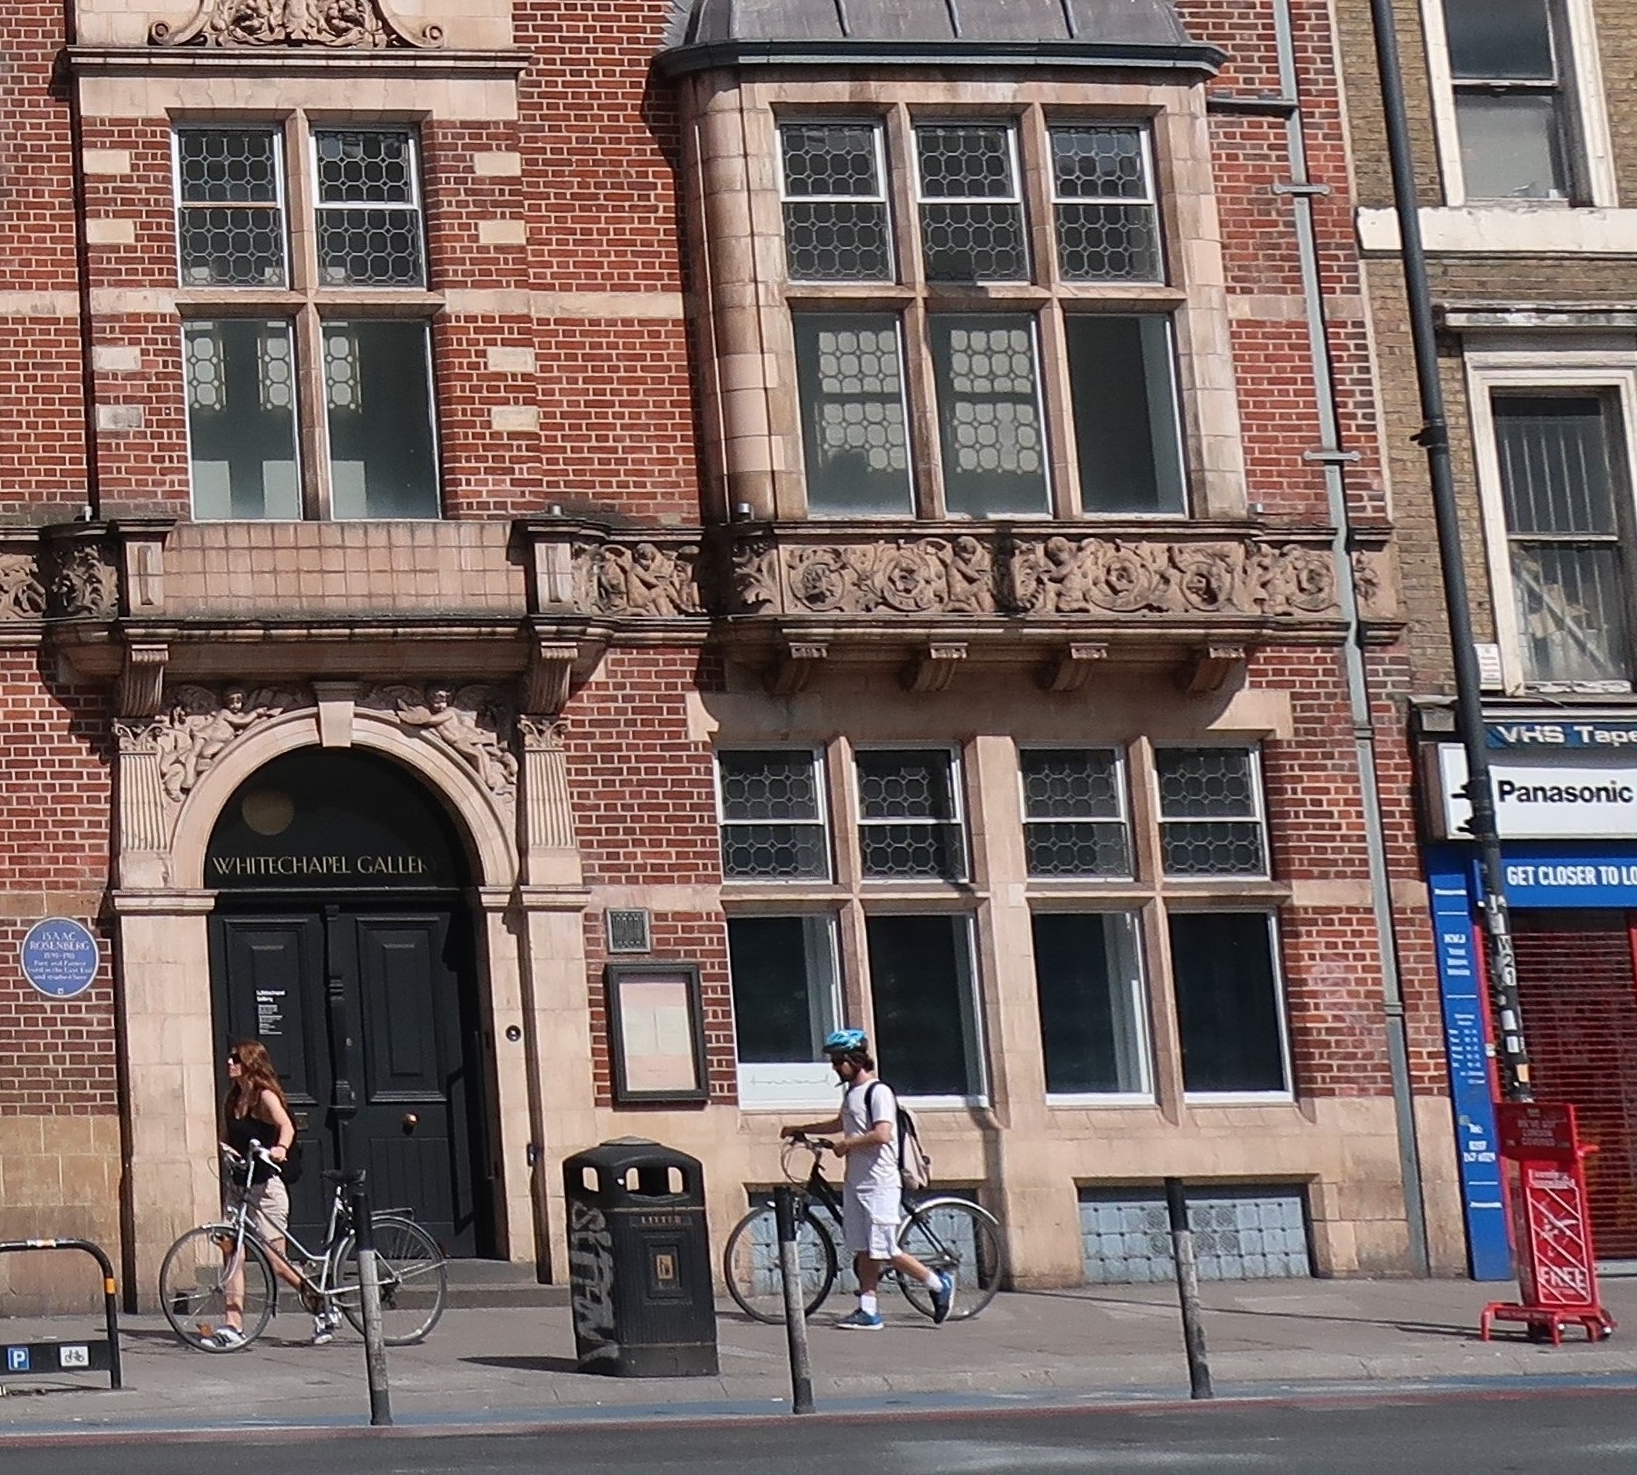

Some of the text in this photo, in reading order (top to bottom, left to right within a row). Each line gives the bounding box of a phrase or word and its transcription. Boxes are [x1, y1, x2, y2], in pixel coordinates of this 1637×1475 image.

[1496, 725, 1565, 743] VHS
[1497, 780, 1634, 803] Panasonic
[212, 856, 352, 875] WHITECHAPEL
[1507, 866, 1535, 886] GET
[1539, 866, 1597, 886] CLOSER
[1598, 866, 1619, 885] TO
[42, 932, 76, 940] ISAAC
[30, 941, 90, 950] ROSENBERG
[13, 1351, 26, 1368] P
